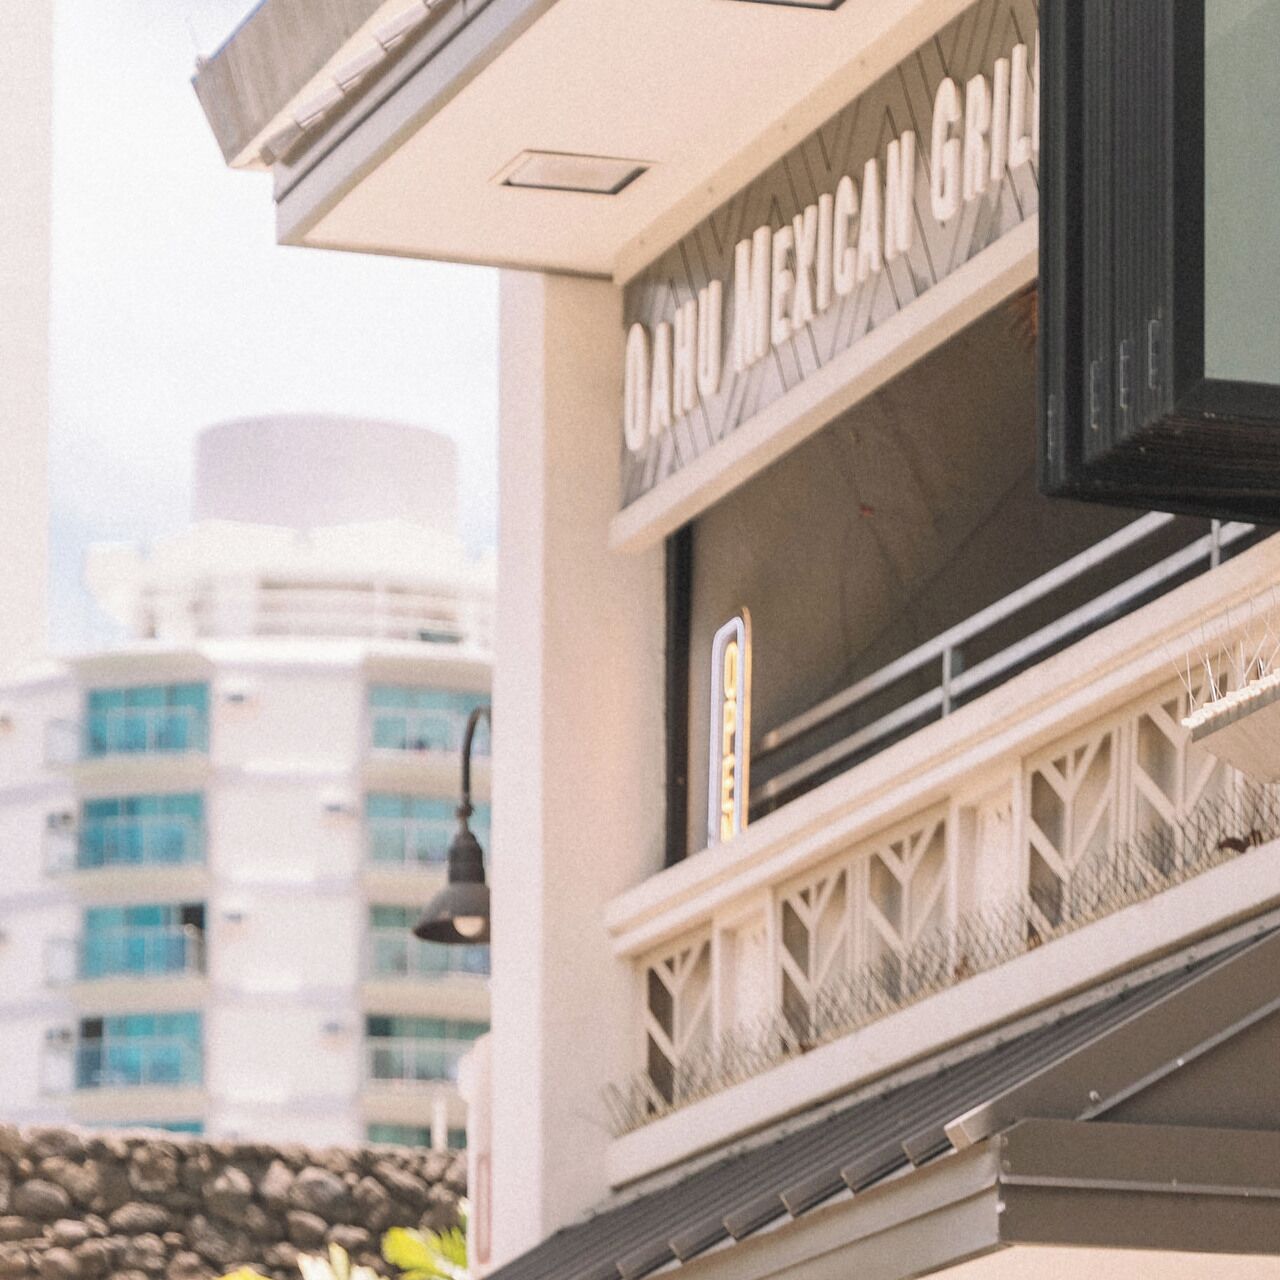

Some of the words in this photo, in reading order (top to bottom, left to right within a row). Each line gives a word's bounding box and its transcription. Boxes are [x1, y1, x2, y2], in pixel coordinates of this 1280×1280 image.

[623, 279, 723, 452] OAHU
[734, 130, 916, 374] MEXICAN
[930, 29, 1040, 221] GRIL
